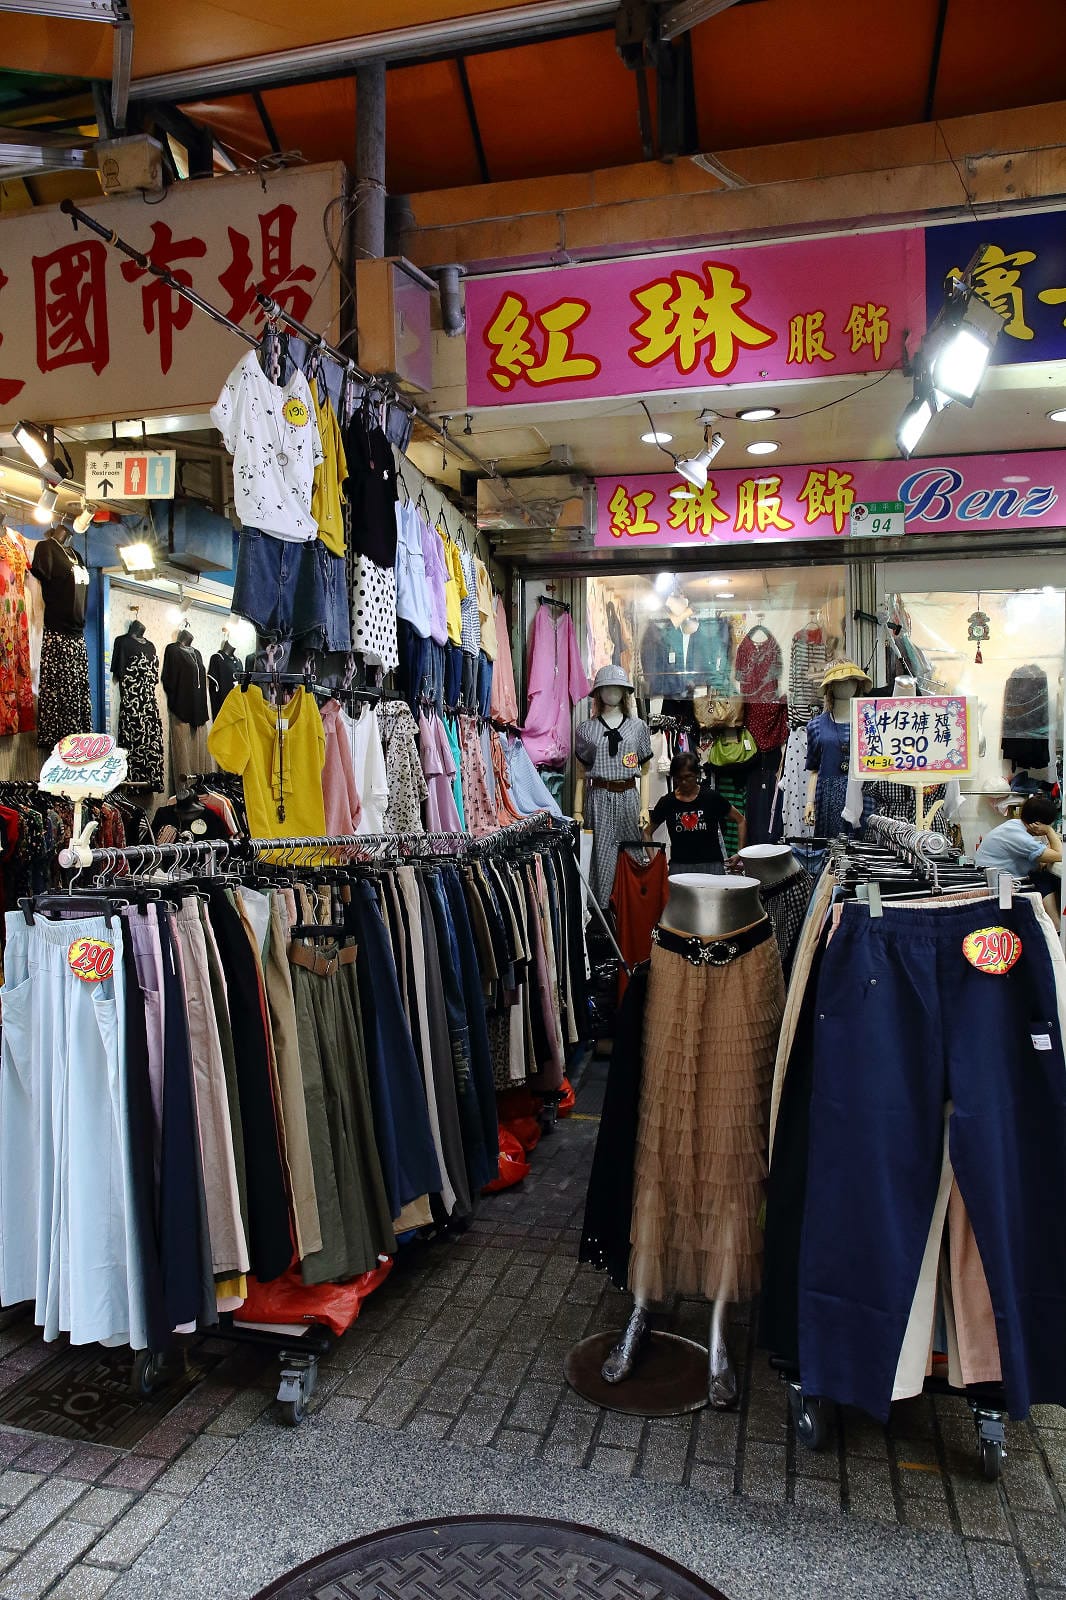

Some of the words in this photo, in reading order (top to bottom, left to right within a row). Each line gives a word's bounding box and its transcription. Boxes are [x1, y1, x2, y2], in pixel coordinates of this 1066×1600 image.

[0, 204, 317, 405] 國市場
[90, 461, 123, 470] 洗手間
[608, 468, 857, 537] 紅琳服飾
[898, 467, 1059, 522] Benz
[871, 518, 892, 533] 94
[877, 711, 930, 734] 牛仔褲
[934, 713, 952, 747] 短褲
[890, 736, 929, 755] 390
[43, 765, 116, 782] 有加大尺寸
[866, 759, 895, 767] M-3L
[895, 755, 928, 770] 290
[675, 810, 704, 821] KP
[70, 942, 114, 976] 290
[972, 932, 1014, 967] 290
